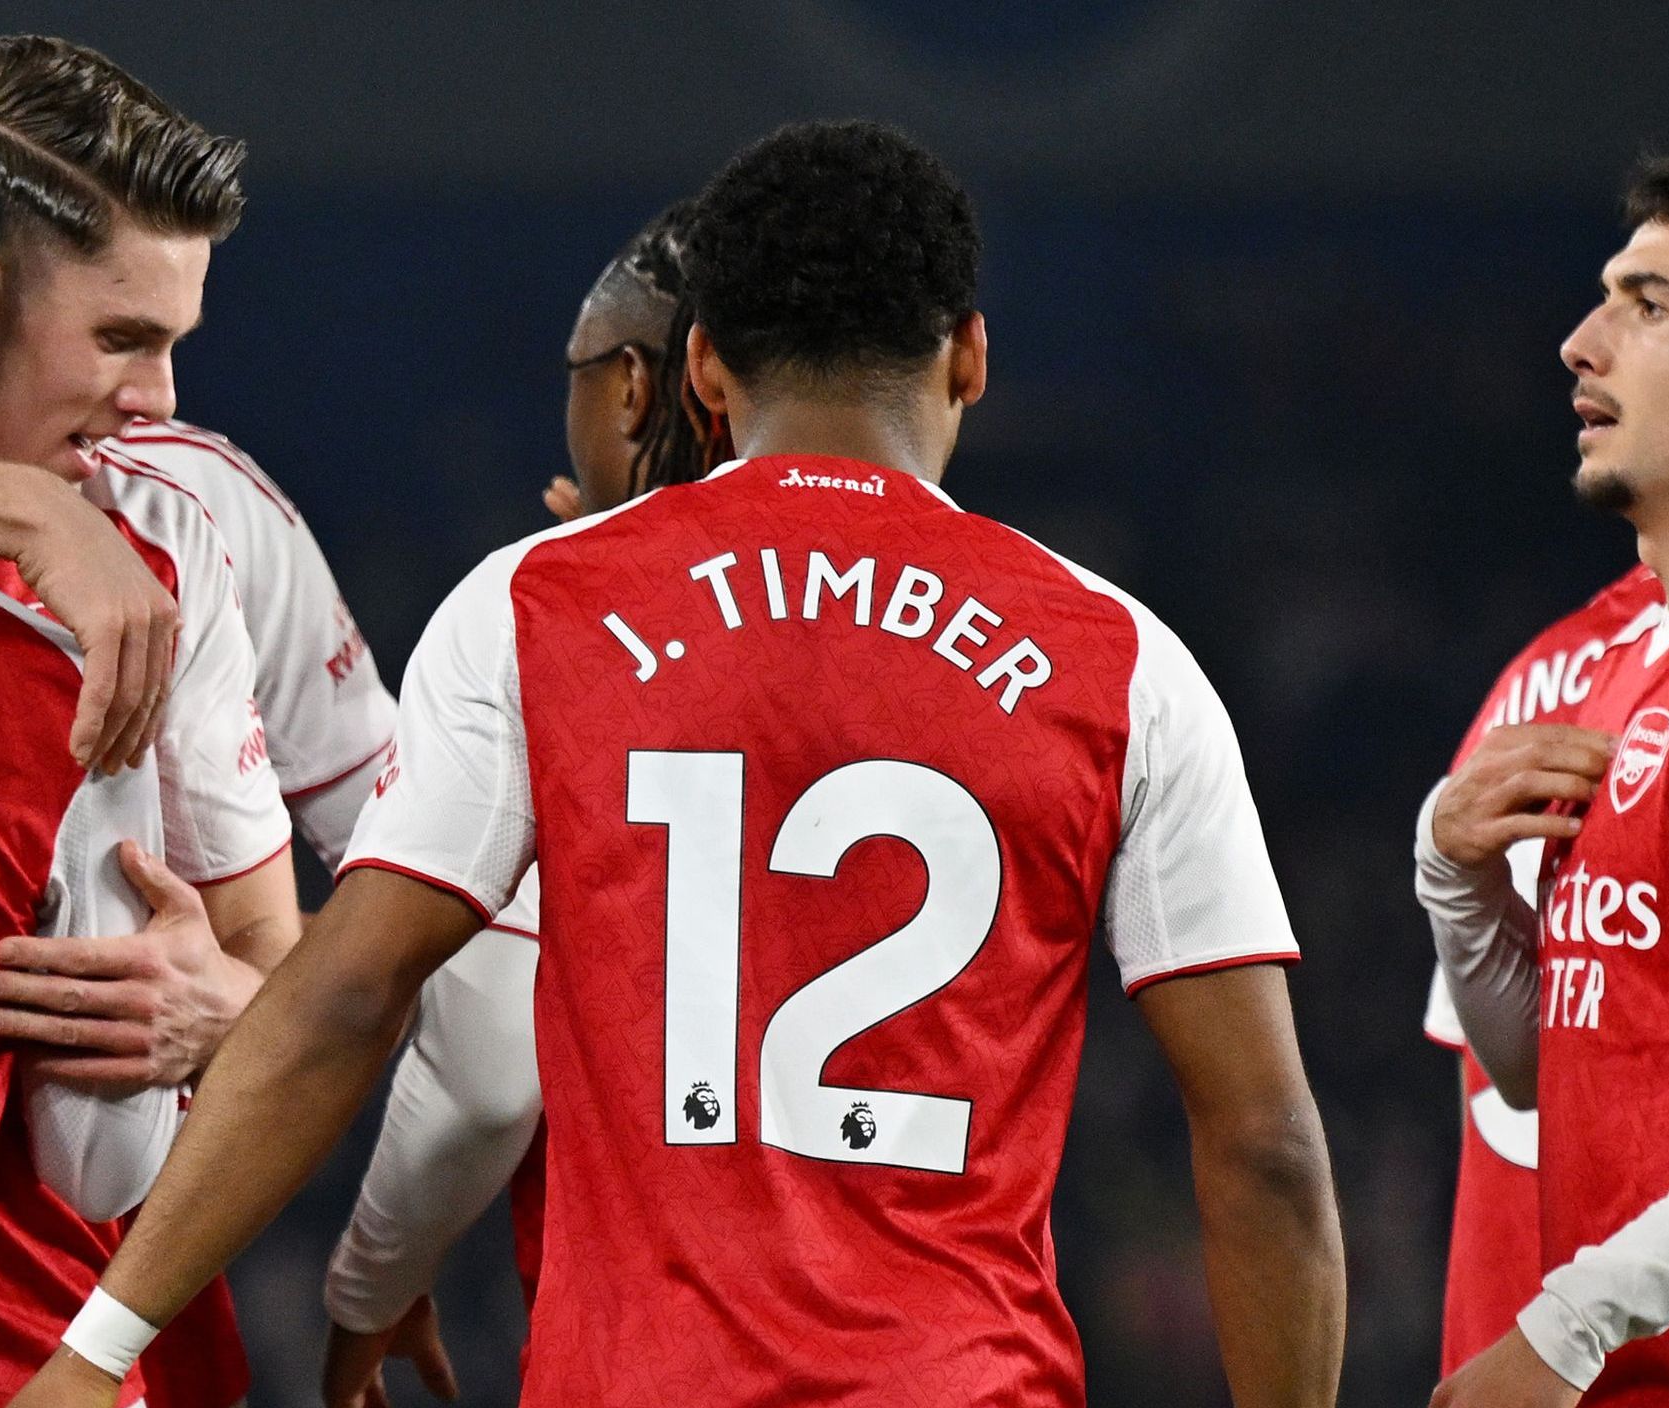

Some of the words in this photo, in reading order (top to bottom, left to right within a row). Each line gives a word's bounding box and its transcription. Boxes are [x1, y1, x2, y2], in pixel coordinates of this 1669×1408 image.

[778, 468, 886, 497] Arsenal
[602, 612, 685, 684] J.
[689, 548, 1054, 715] TIMBER
[625, 749, 1002, 1175] 12
